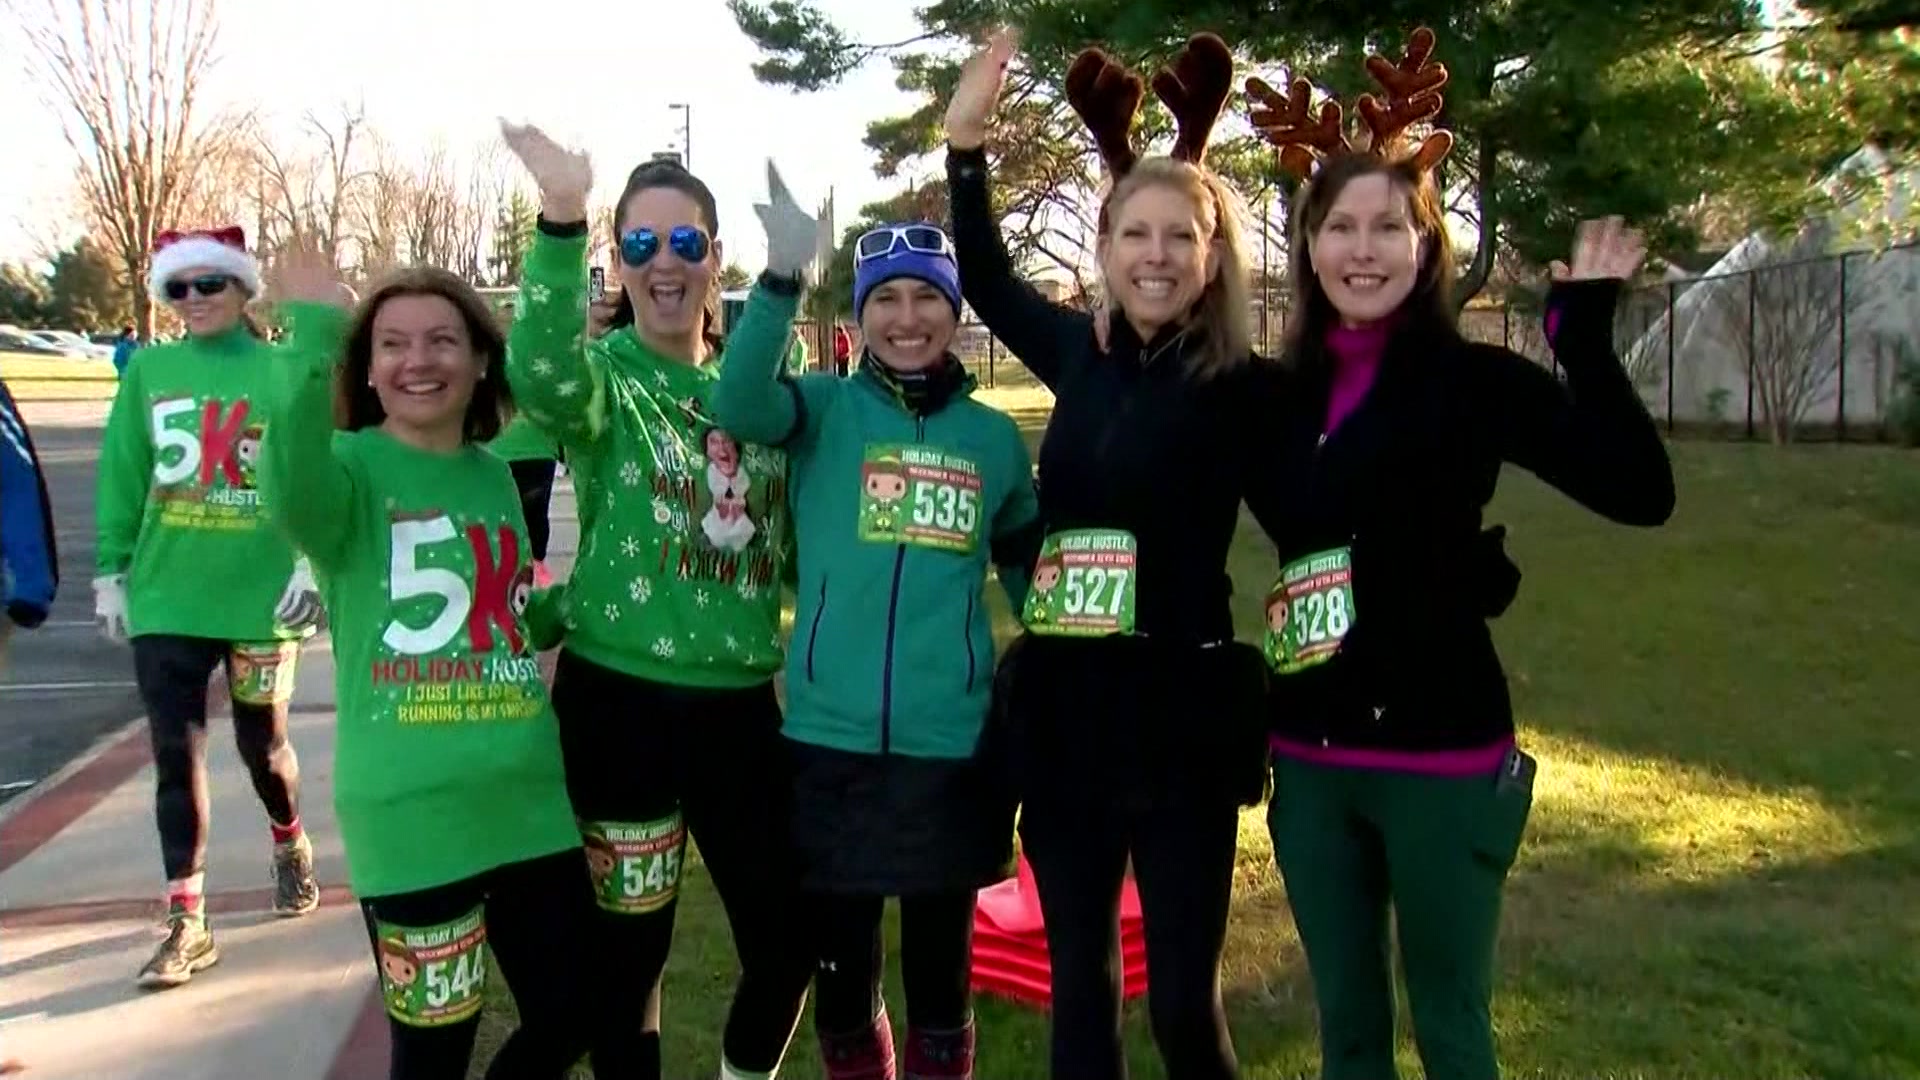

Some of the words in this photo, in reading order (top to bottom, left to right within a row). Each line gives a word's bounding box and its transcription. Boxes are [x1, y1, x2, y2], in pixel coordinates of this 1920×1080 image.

[152, 398, 249, 486] 5K
[902, 449, 942, 466] HOLIDAY
[913, 481, 976, 533] 535
[1092, 535, 1129, 550] HUSTLE
[1310, 554, 1345, 576] HUSTLE
[382, 515, 523, 655] 5K
[1064, 566, 1128, 616] 527
[1294, 587, 1349, 646] 528
[372, 656, 483, 687] HOLIDAY
[406, 685, 412, 702] I
[415, 683, 452, 702] JUST
[457, 683, 485, 701] LIKE
[398, 704, 462, 722] RUNNING
[466, 704, 479, 720] IS
[606, 828, 648, 841] HOLIDAY
[623, 845, 680, 897] 545
[406, 927, 450, 948] HOLIDAY
[426, 942, 485, 1008] 544
